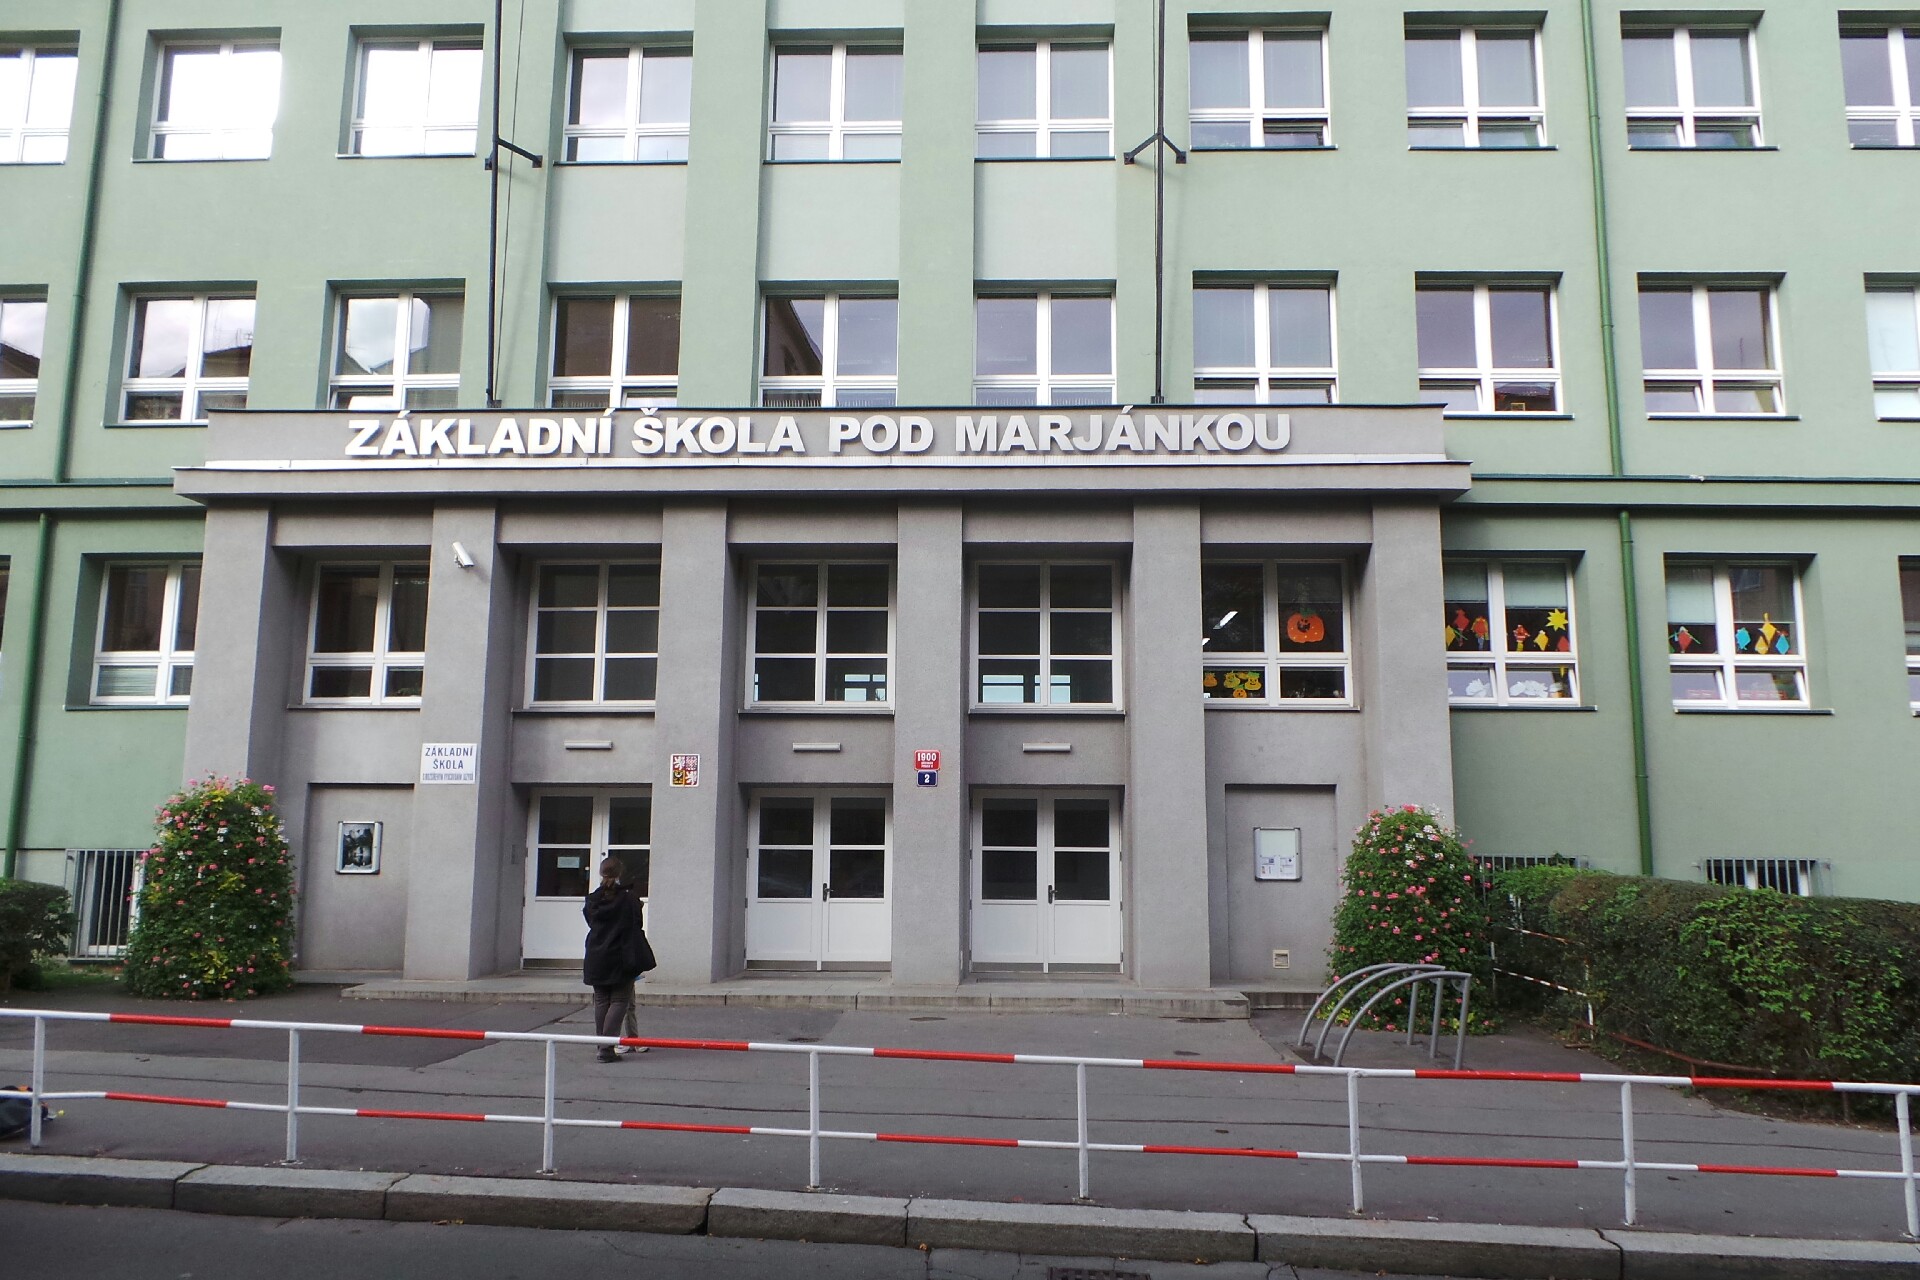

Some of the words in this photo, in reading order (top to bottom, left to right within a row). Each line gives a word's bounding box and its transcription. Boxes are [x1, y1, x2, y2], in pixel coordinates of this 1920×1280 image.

[344, 408, 613, 455] ZÁKLADNÍ
[631, 407, 806, 454] ŠKOLA
[828, 415, 934, 452] POD
[955, 405, 1291, 451] MARJÁNKOU
[425, 745, 473, 757] ZÁKLADNÍ
[917, 752, 937, 762] 1900
[432, 758, 464, 770] ŠKOLA
[924, 773, 930, 784] 2
